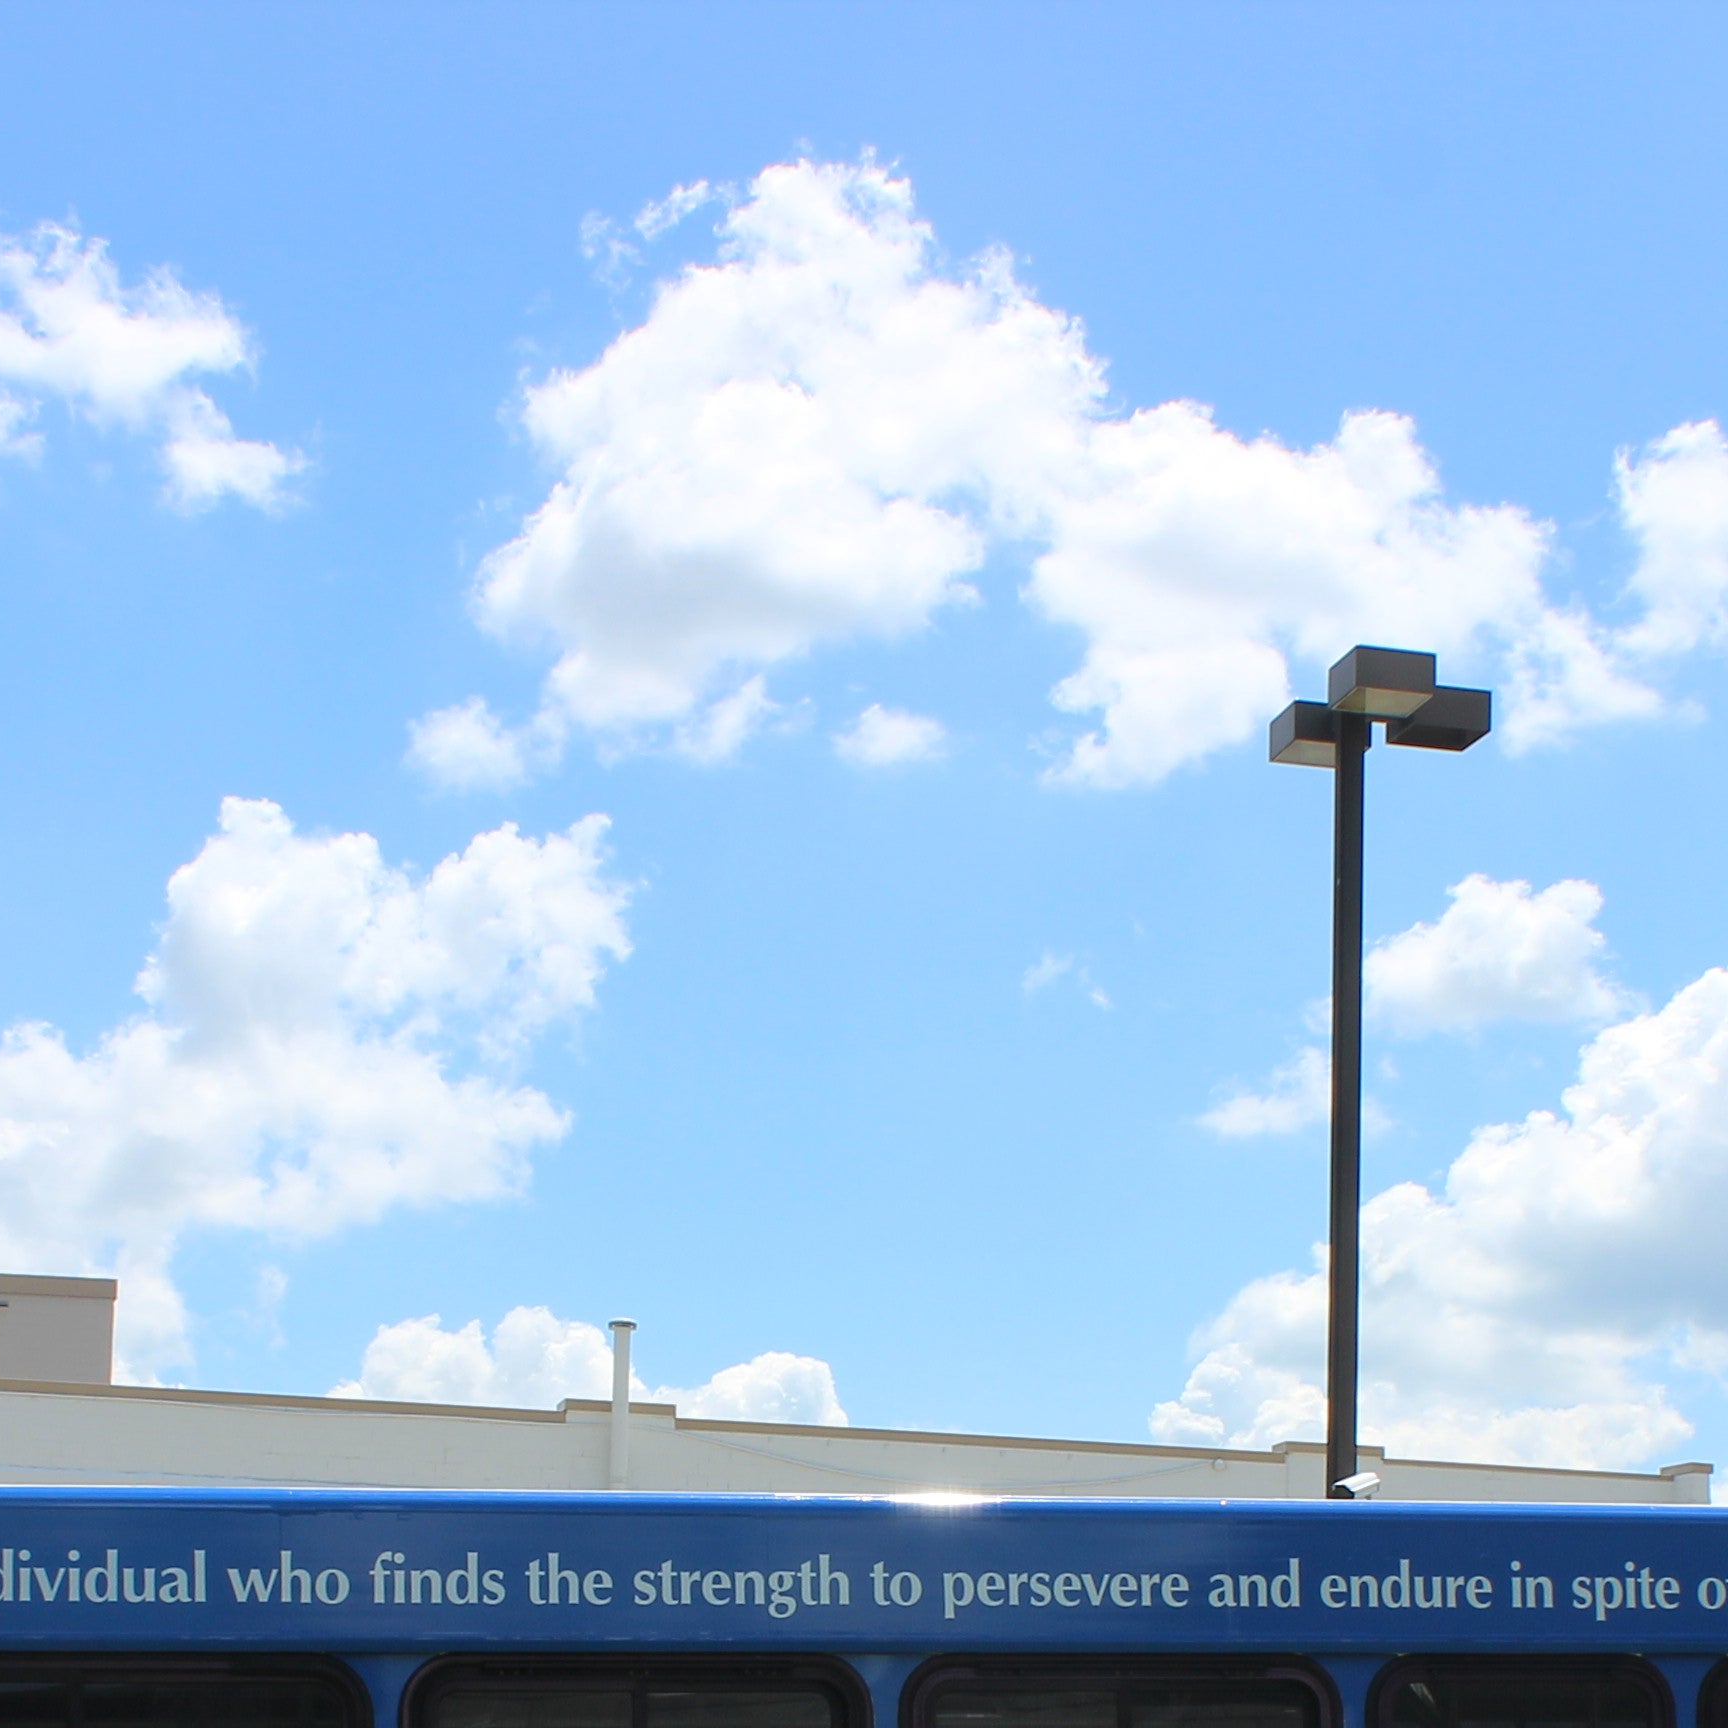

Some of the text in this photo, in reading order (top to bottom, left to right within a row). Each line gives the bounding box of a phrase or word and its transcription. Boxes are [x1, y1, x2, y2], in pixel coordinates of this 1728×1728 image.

[228, 1551, 349, 1604] who
[369, 1552, 505, 1604] finds
[525, 1553, 612, 1604] the
[634, 1554, 849, 1618] strength
[870, 1562, 922, 1605] to
[943, 1573, 1188, 1618] persevere
[1209, 1558, 1299, 1607] and
[1321, 1559, 1492, 1608] endure
[1512, 1561, 1553, 1607] in
[1573, 1562, 1679, 1620] spite
